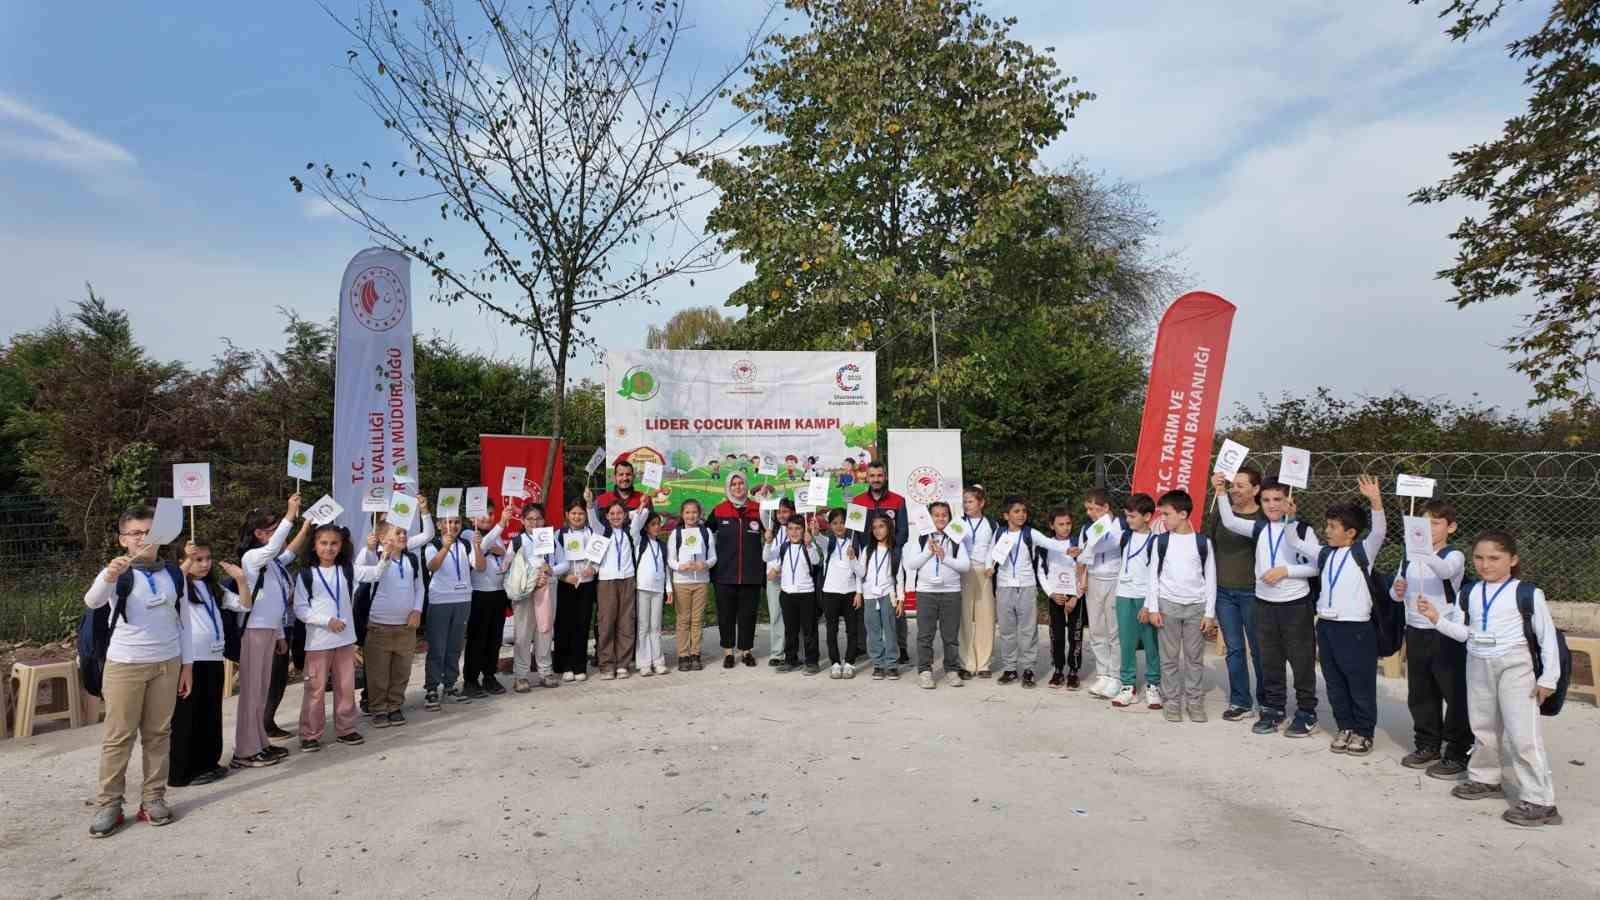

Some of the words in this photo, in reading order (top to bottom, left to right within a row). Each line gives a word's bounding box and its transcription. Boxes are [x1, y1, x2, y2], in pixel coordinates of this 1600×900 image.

[1169, 390, 1184, 411] VE
[1184, 346, 1211, 433] BAKANLIĞI
[645, 416, 689, 430] LİDER
[694, 418, 743, 433] ÇOCUK
[746, 418, 790, 430] TARIM
[795, 417, 840, 429] KAMPI
[368, 412, 384, 474] VALİLİĞİ
[1160, 414, 1180, 463] TARIM
[351, 457, 365, 484] T.C.
[1156, 467, 1173, 494] T.C.
